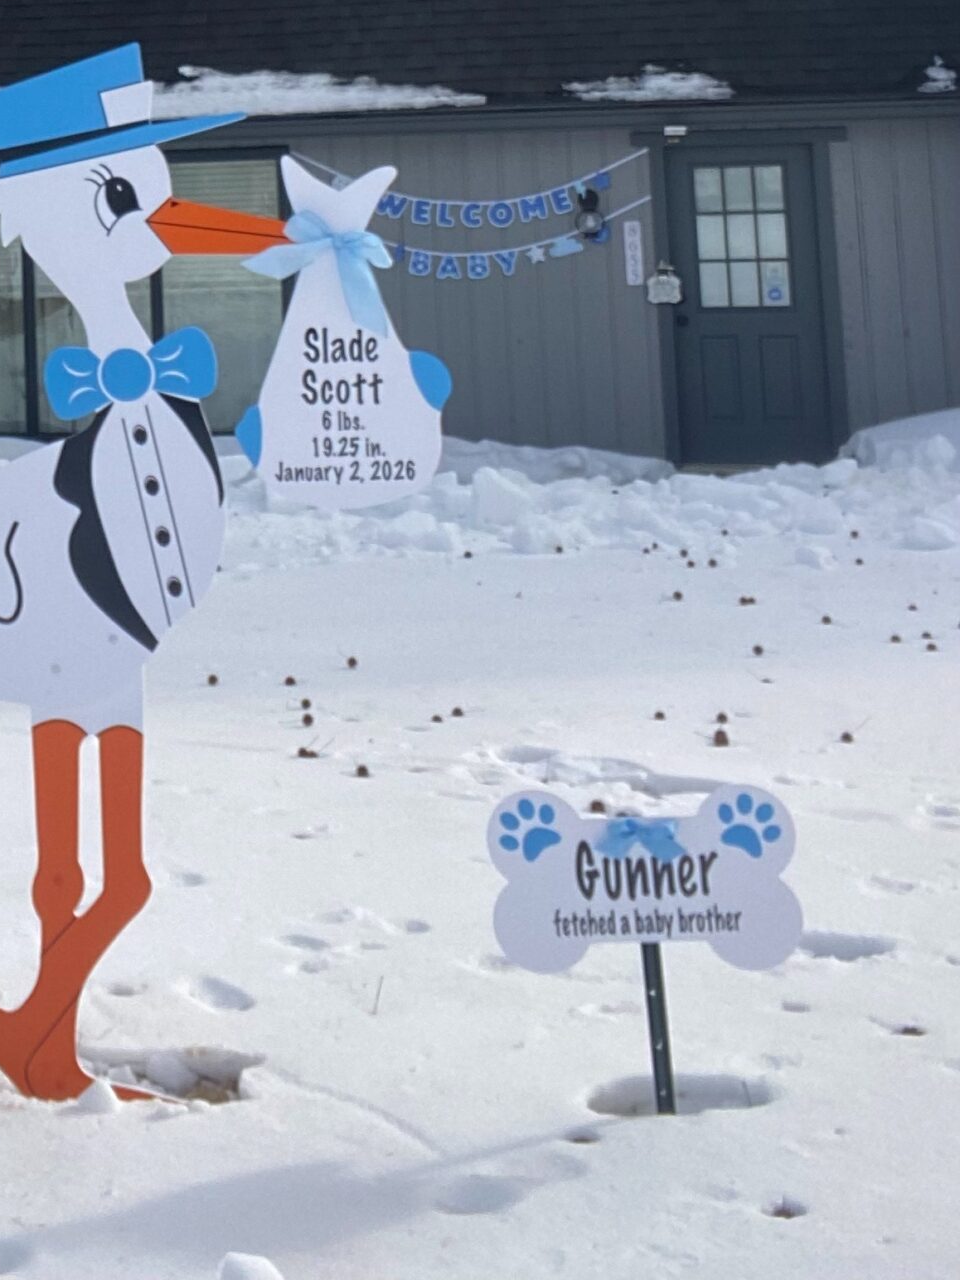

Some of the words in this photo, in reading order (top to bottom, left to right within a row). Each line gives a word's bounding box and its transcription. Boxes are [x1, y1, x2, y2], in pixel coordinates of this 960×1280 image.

[377, 188, 572, 227] WELCOME
[409, 249, 518, 279] BABY
[304, 327, 378, 363] Slade
[301, 369, 383, 405] Scott
[322, 411, 332, 430] 6
[338, 411, 365, 431] lbs.
[313, 437, 360, 457] 19.25
[366, 438, 386, 457] in.
[275, 462, 344, 484] January
[350, 461, 365, 483] 2,
[370, 460, 416, 480] 2026
[576, 840, 718, 900] Gunner
[553, 908, 616, 937] fetched
[621, 914, 631, 934] a
[635, 908, 674, 938] baby
[678, 904, 742, 933] brother
